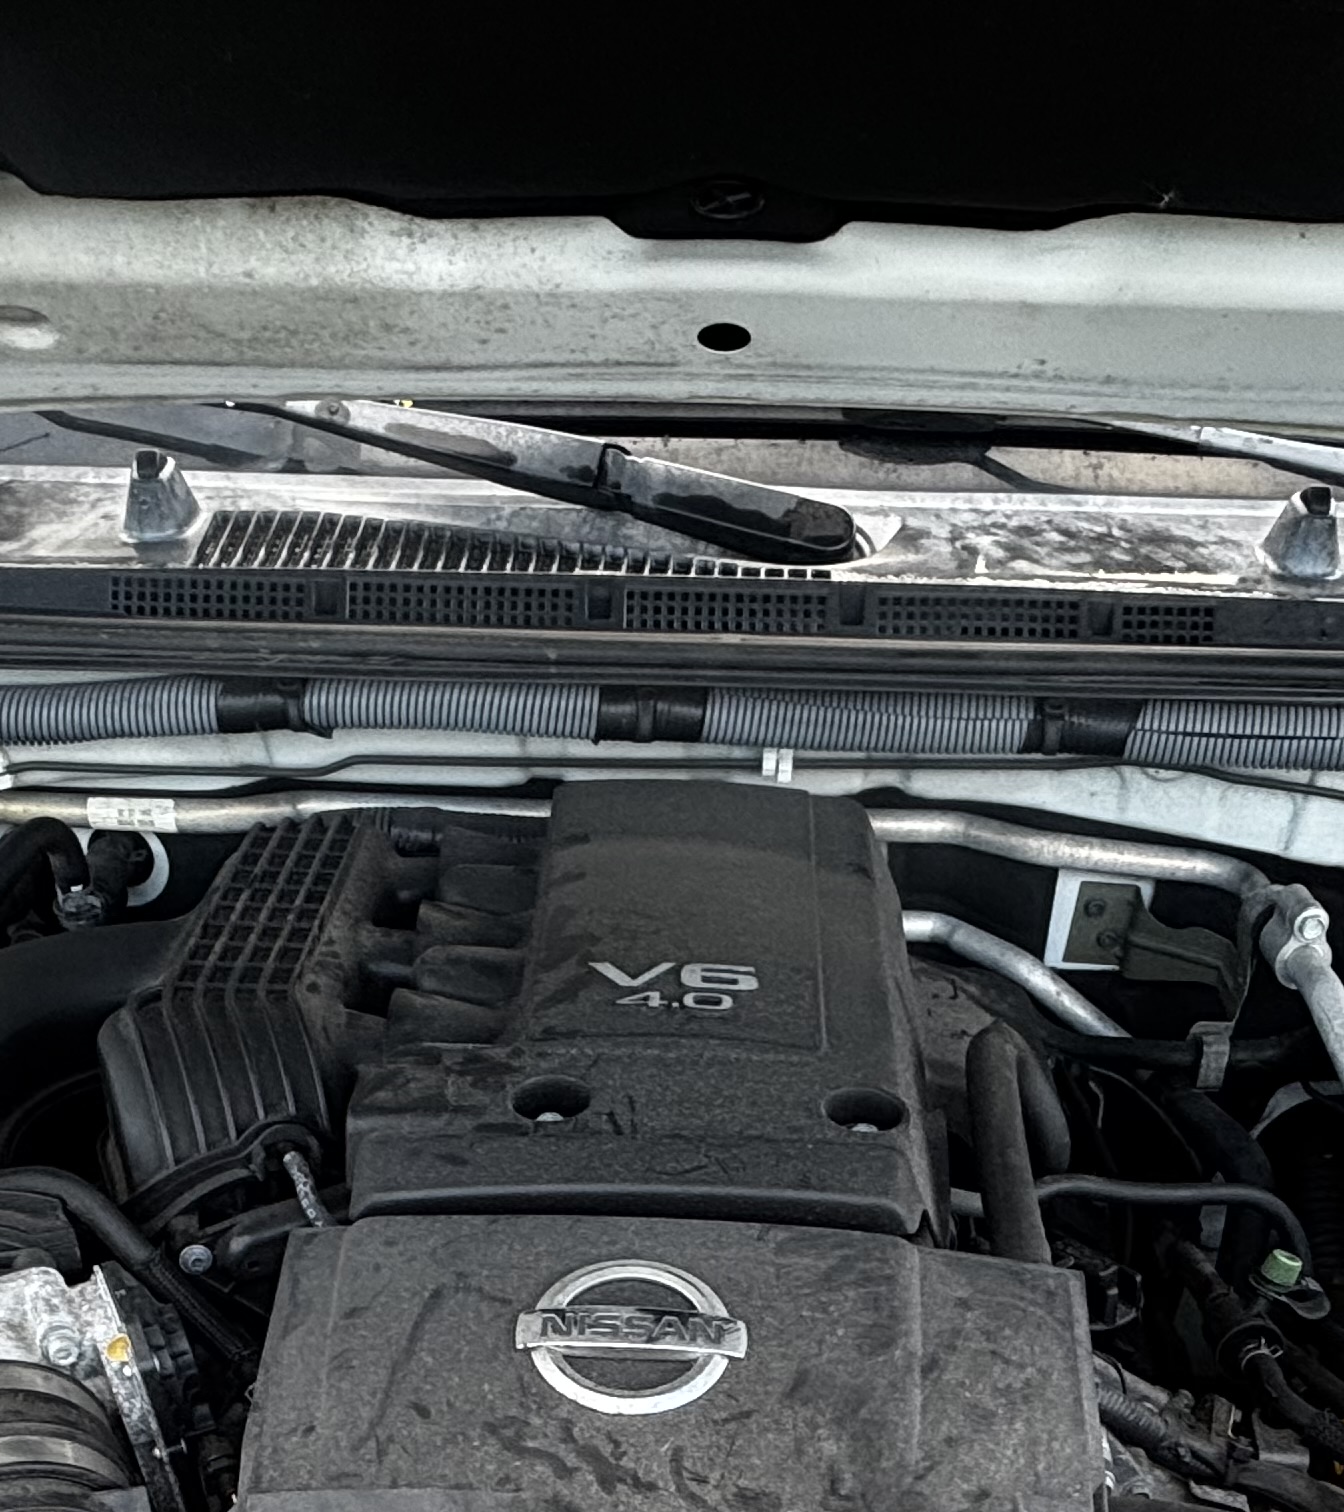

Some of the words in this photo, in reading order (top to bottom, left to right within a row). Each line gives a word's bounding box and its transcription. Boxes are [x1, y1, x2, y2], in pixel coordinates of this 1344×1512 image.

[589, 961, 759, 991] V6
[615, 990, 735, 1011] 4.0
[540, 1312, 726, 1344] NISSAN
